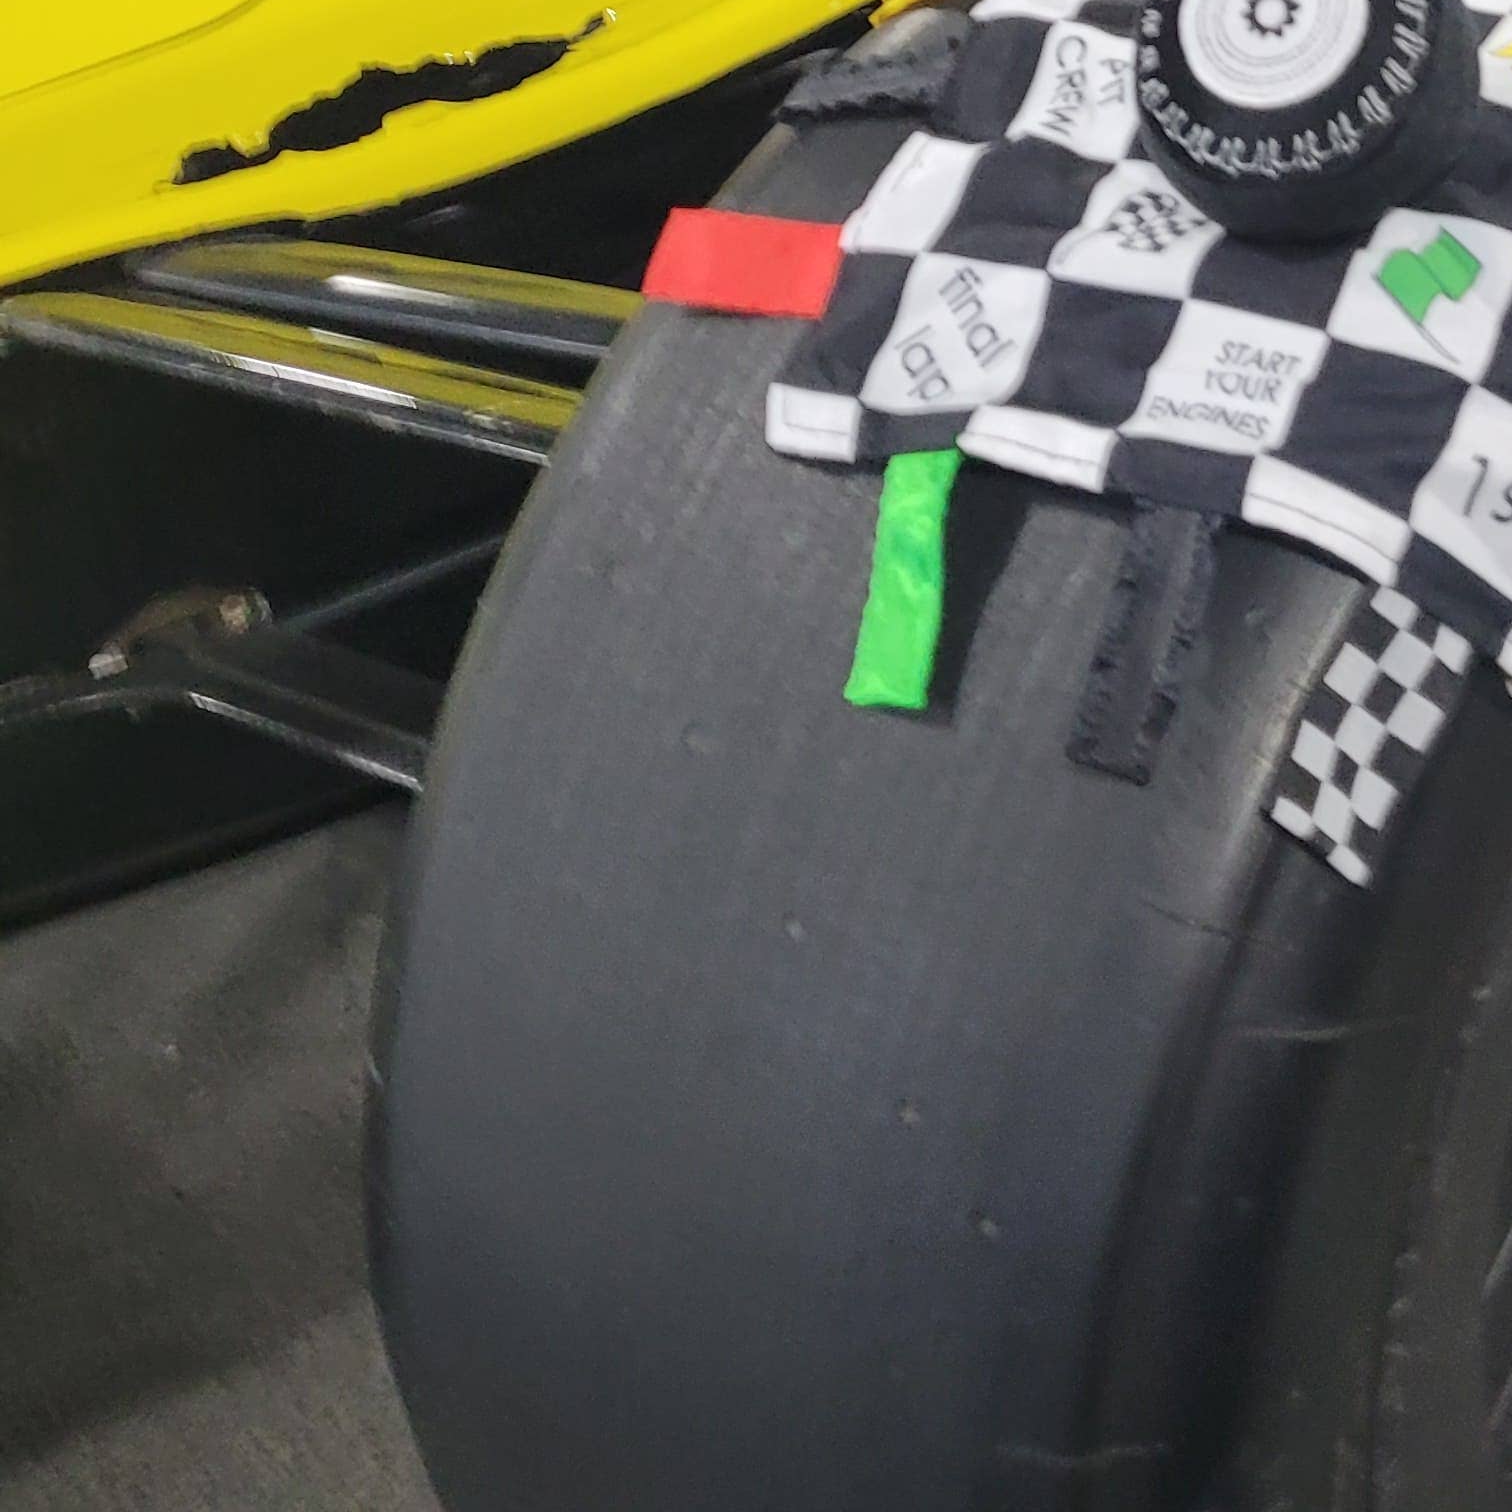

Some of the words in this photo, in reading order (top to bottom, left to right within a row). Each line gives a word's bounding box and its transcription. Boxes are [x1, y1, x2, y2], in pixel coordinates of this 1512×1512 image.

[1038, 35, 1088, 137] CREW
[893, 324, 952, 400] lap
[1214, 340, 1302, 376] START
[1204, 369, 1283, 404] YOUR
[1147, 395, 1270, 440] ENGINES
